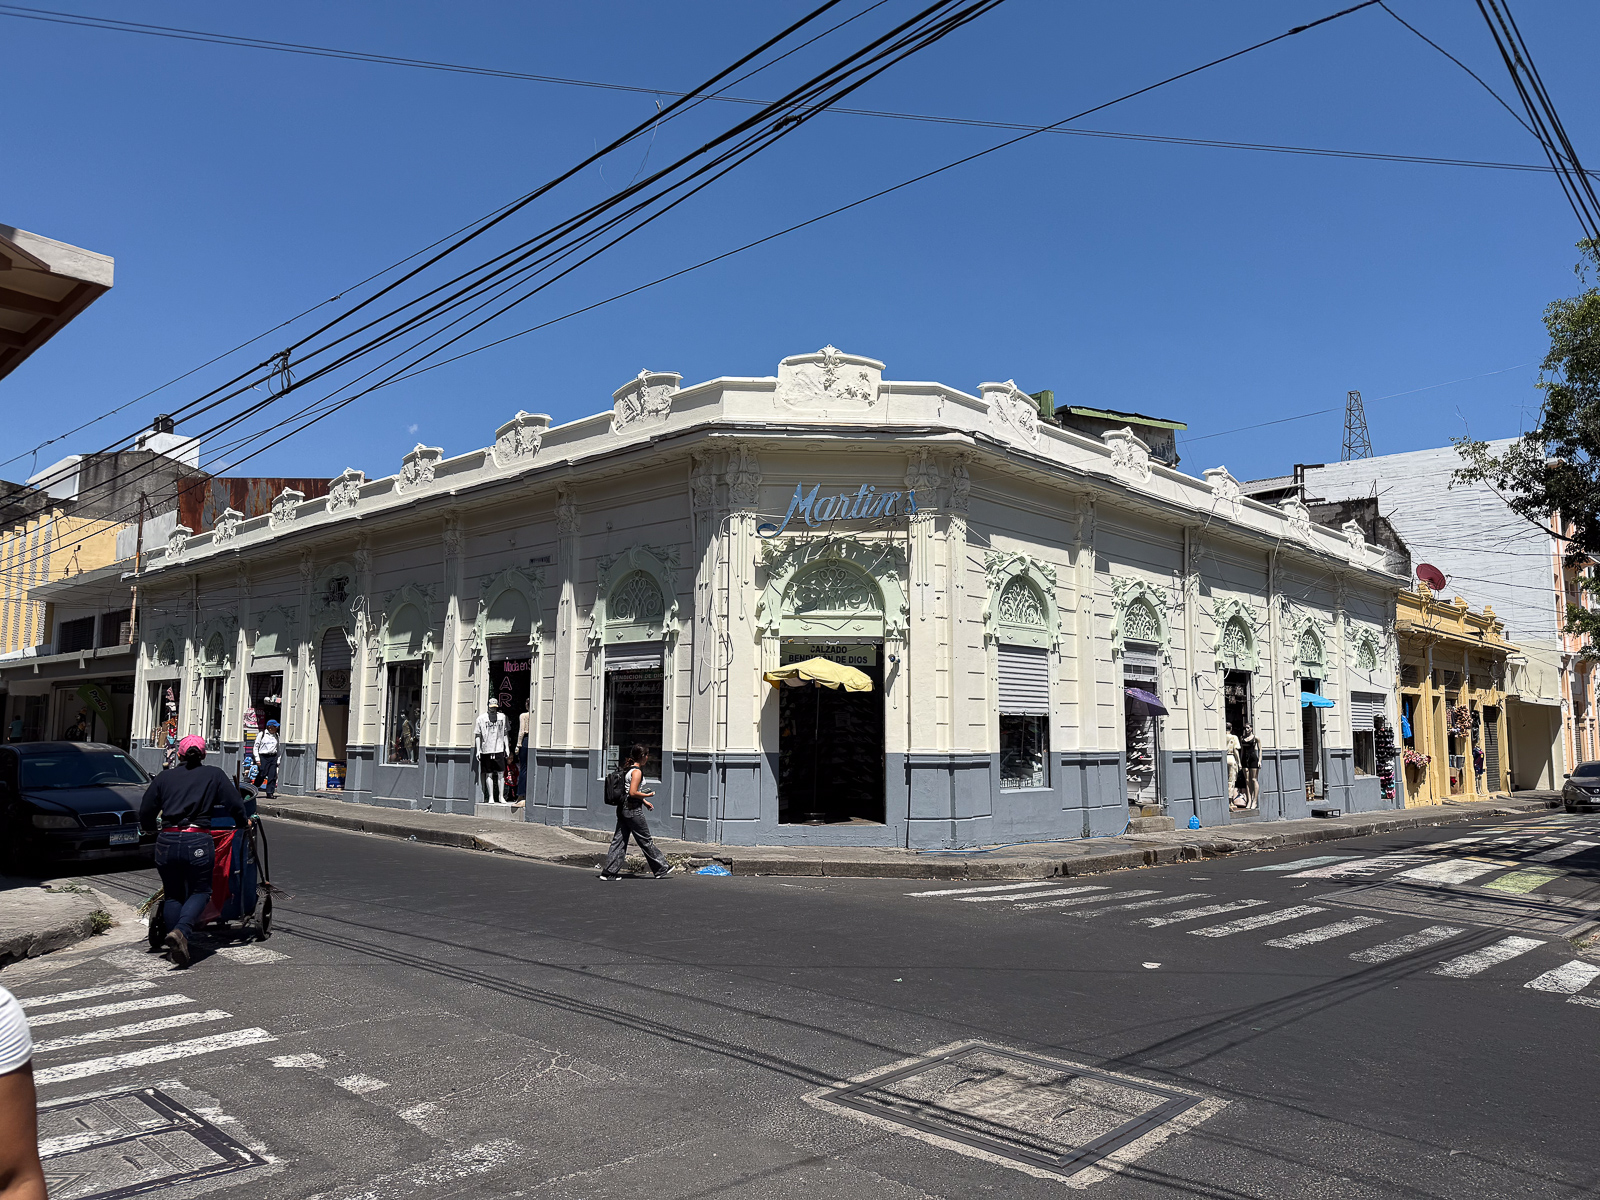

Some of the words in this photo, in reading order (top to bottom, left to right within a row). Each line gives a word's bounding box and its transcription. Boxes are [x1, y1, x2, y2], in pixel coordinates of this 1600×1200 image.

[810, 646, 847, 654] CALZADO
[849, 656, 868, 664] DIOS
[520, 661, 528, 671] en
[88, 689, 108, 711] Prado
